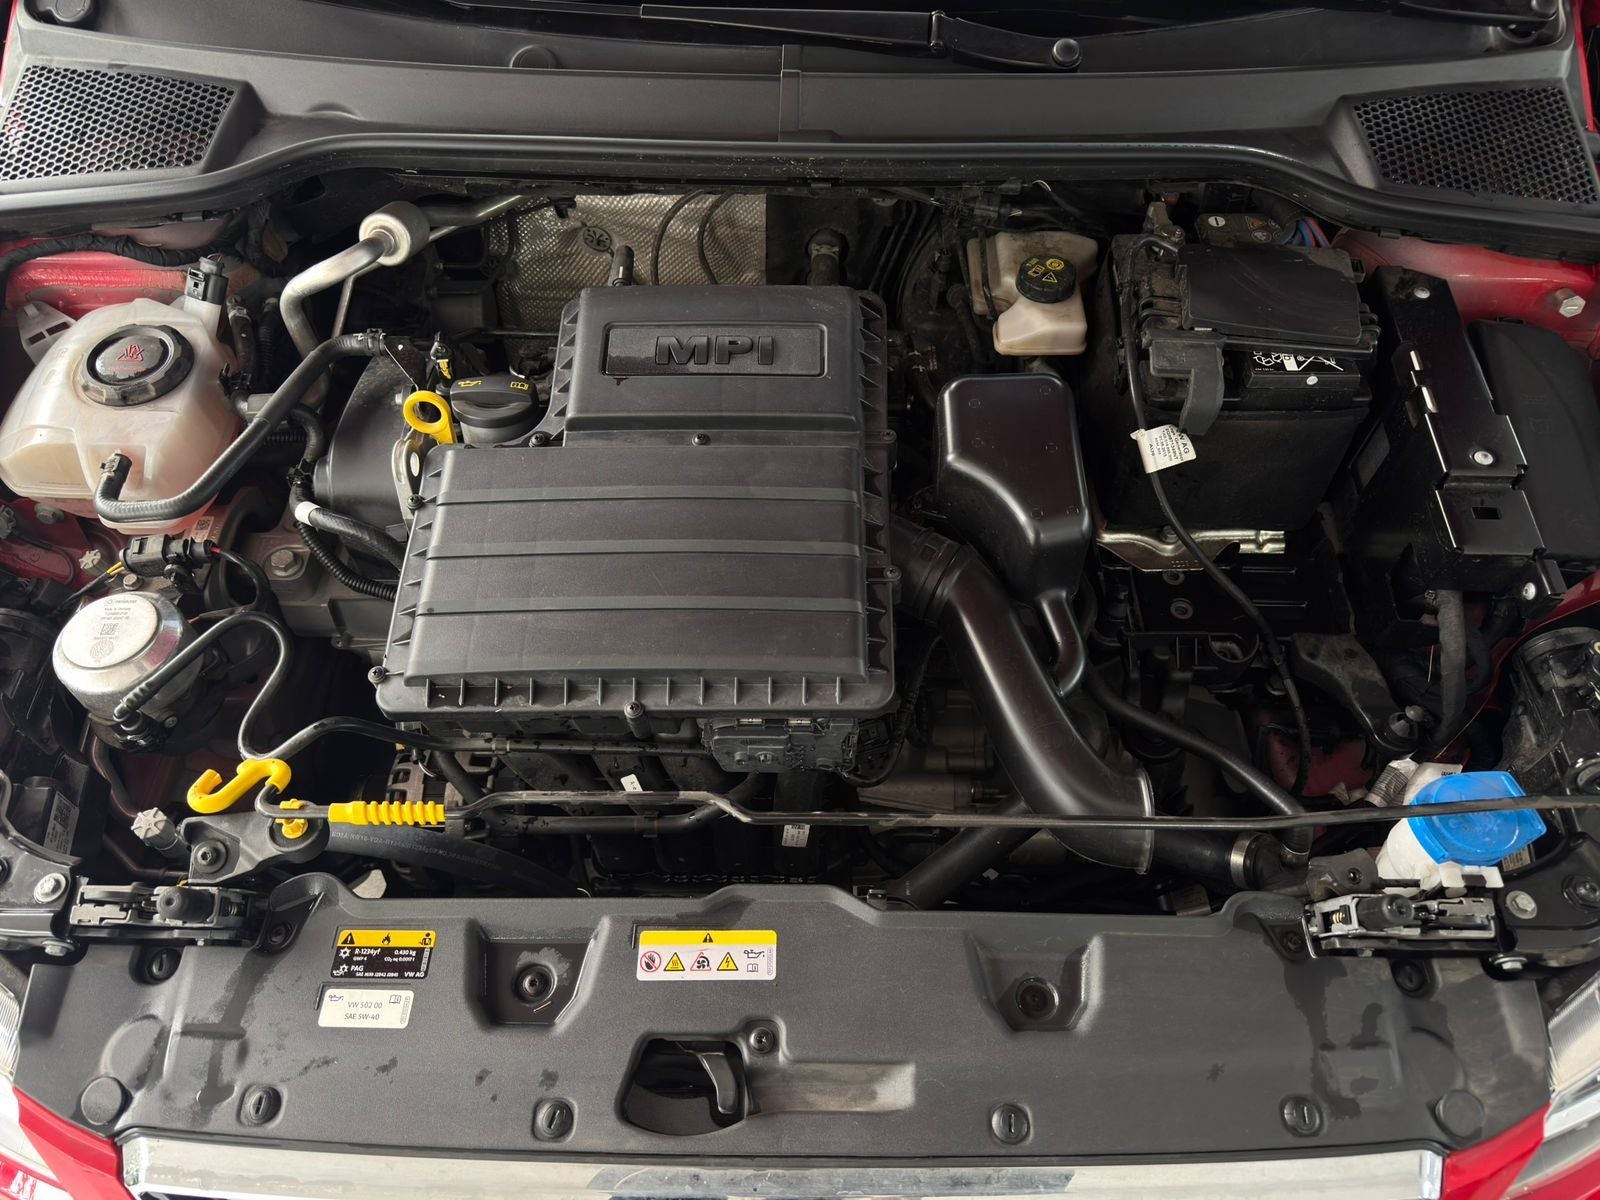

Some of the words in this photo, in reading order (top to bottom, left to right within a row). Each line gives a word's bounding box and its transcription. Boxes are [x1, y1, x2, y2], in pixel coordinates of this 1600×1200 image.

[655, 335, 775, 365] MPI
[354, 948, 381, 956] R-1234yf
[409, 949, 417, 957] kg
[344, 1012, 357, 1020] SAE
